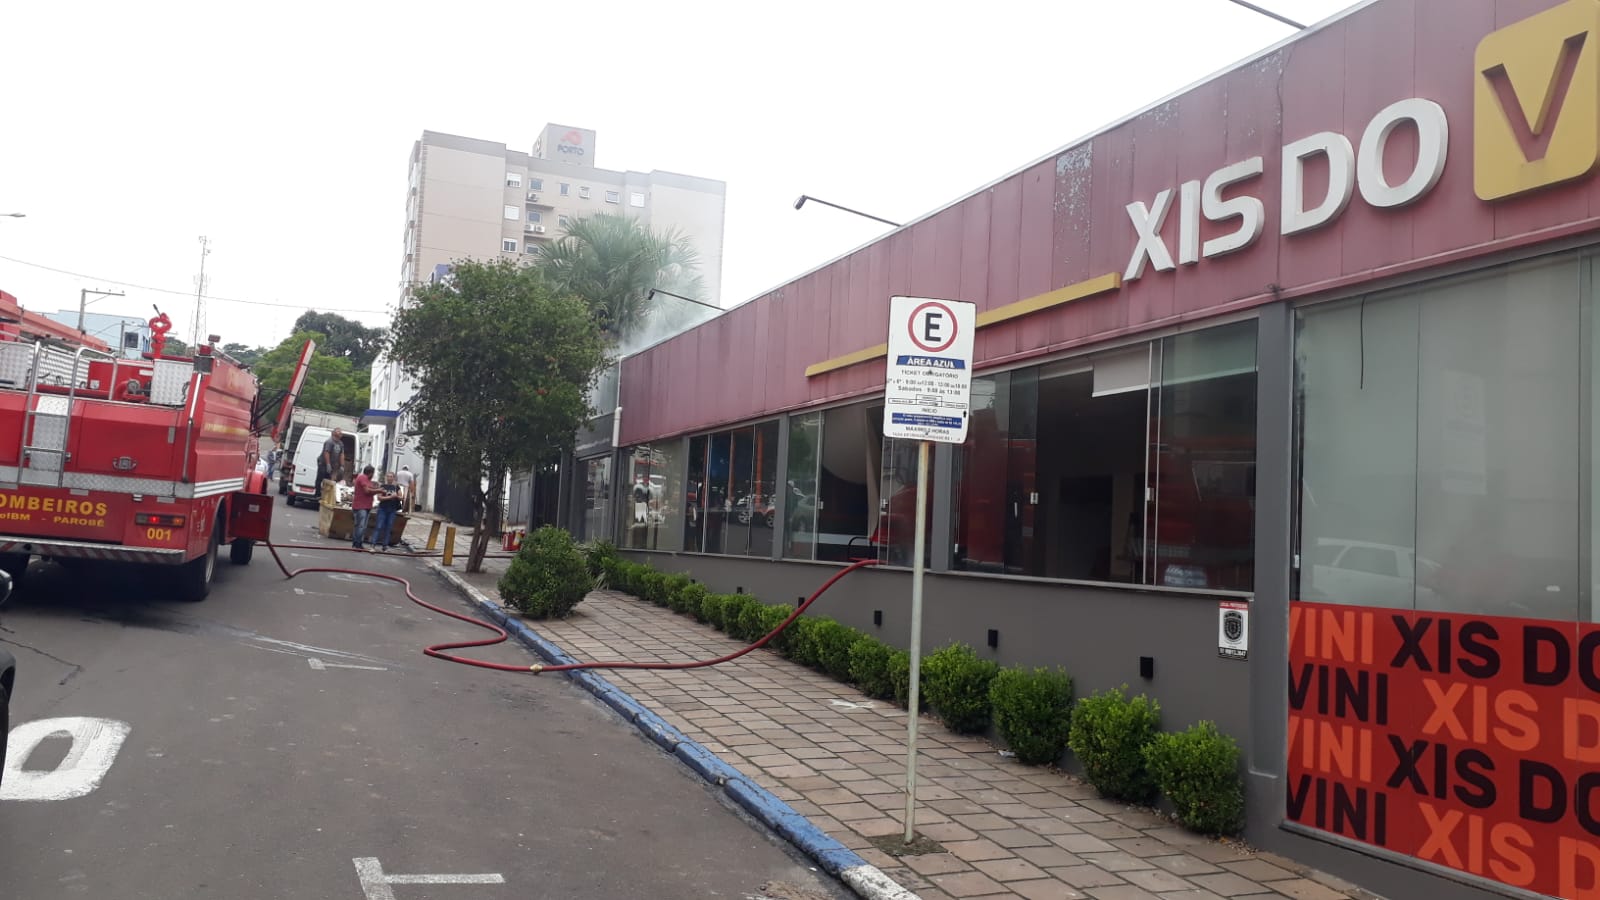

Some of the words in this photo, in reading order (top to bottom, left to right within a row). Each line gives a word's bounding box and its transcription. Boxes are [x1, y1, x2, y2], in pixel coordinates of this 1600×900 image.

[557, 144, 585, 156] PORTO
[1122, 156, 1265, 283] XIS
[1281, 96, 1449, 237] DO
[924, 312, 943, 343] E
[906, 355, 932, 367] ÁREA
[932, 358, 956, 369] AZUL
[53, 515, 105, 528] PAROBÉ
[146, 527, 172, 542] 001
[1390, 615, 1501, 679] XIS
[1288, 660, 1388, 726] VINI
[1422, 677, 1541, 752] XIS
[1386, 733, 1497, 809] XIS
[1287, 773, 1387, 846] VINI
[1417, 801, 1536, 887] XIS
